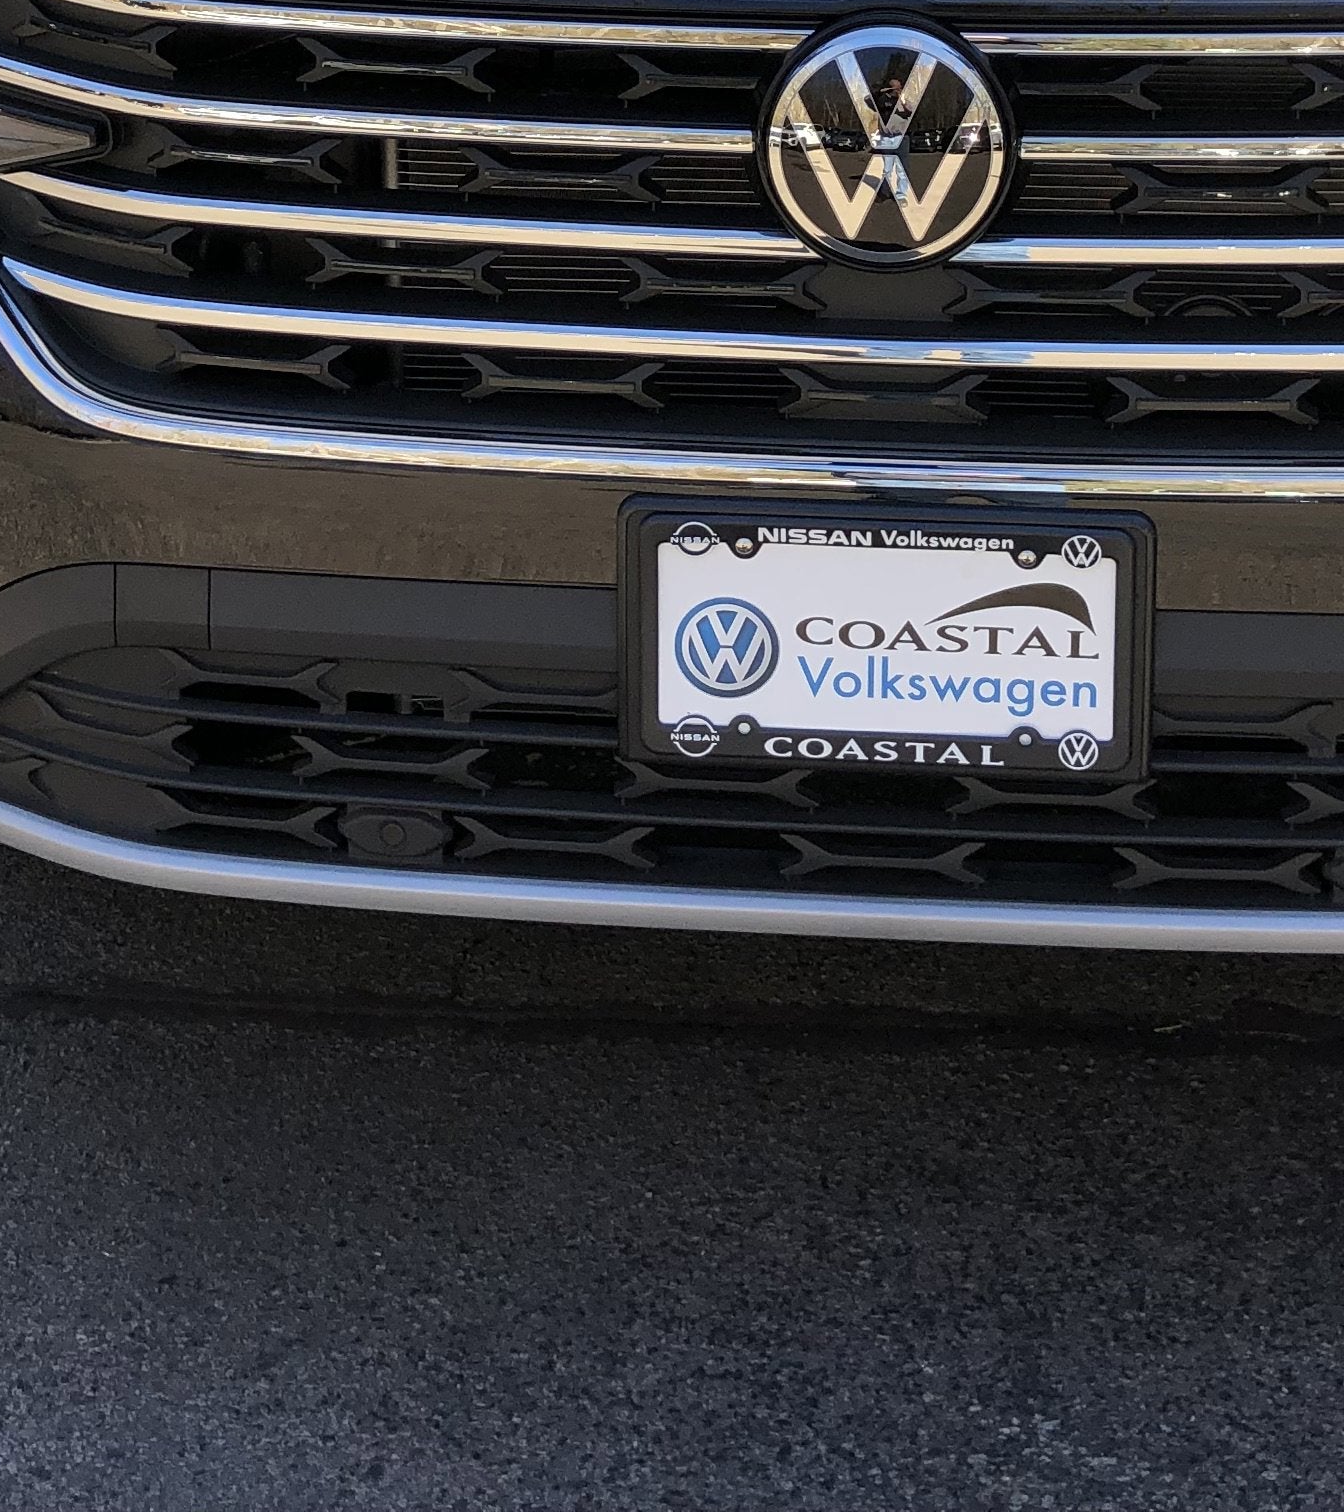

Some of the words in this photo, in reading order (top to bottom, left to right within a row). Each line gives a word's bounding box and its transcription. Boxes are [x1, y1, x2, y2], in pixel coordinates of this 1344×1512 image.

[784, 44, 990, 244] VW
[670, 534, 720, 545] NISSAN
[757, 526, 873, 547] NISSAN
[880, 529, 1015, 552] Volkswagen
[683, 605, 771, 691] VW
[795, 616, 1100, 660] COASTAL
[797, 655, 1098, 716] Volkswagen
[670, 731, 720, 742] NISSAN
[763, 736, 1005, 766] COASTAL
